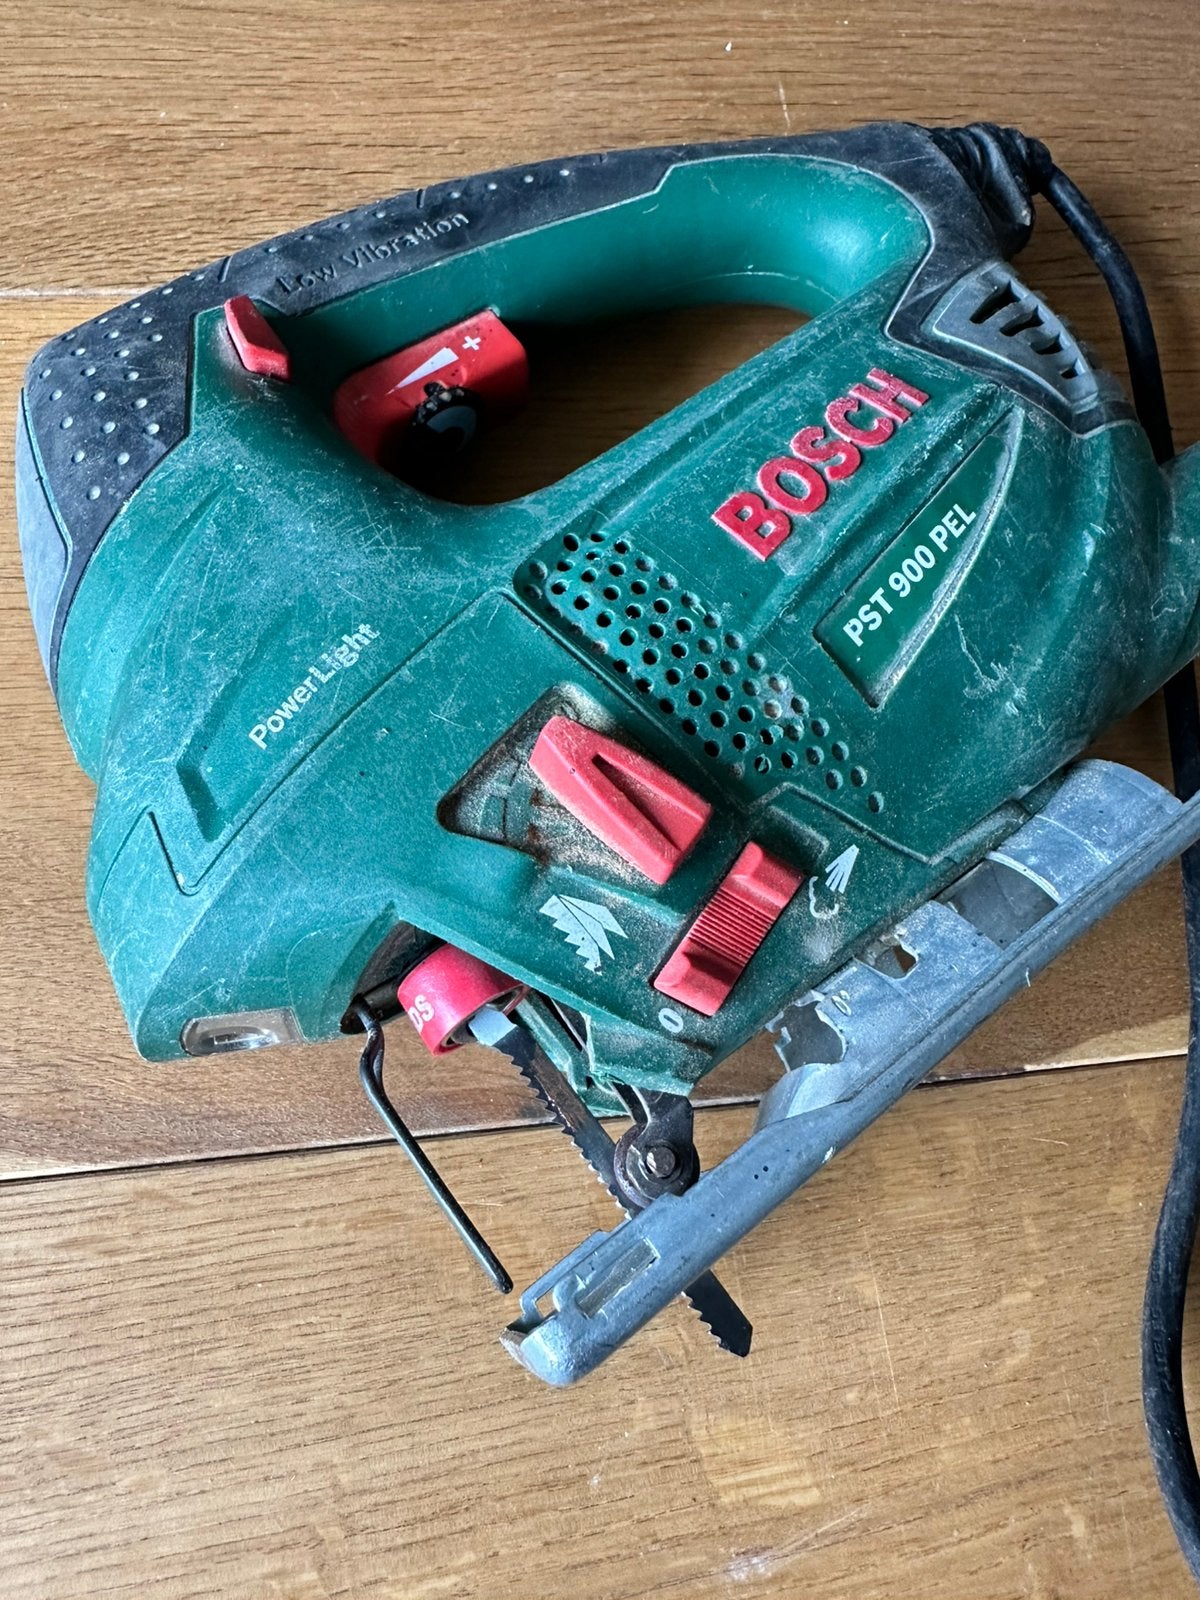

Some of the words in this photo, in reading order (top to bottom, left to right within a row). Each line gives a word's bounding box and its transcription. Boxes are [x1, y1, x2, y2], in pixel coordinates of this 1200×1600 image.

[275, 262, 338, 295] Low
[342, 212, 470, 269] Vibration
[711, 367, 930, 562] BOSCH
[842, 586, 894, 648] PST
[888, 544, 936, 598] 900
[928, 503, 977, 553] PEL
[248, 623, 381, 750] PowerLight
